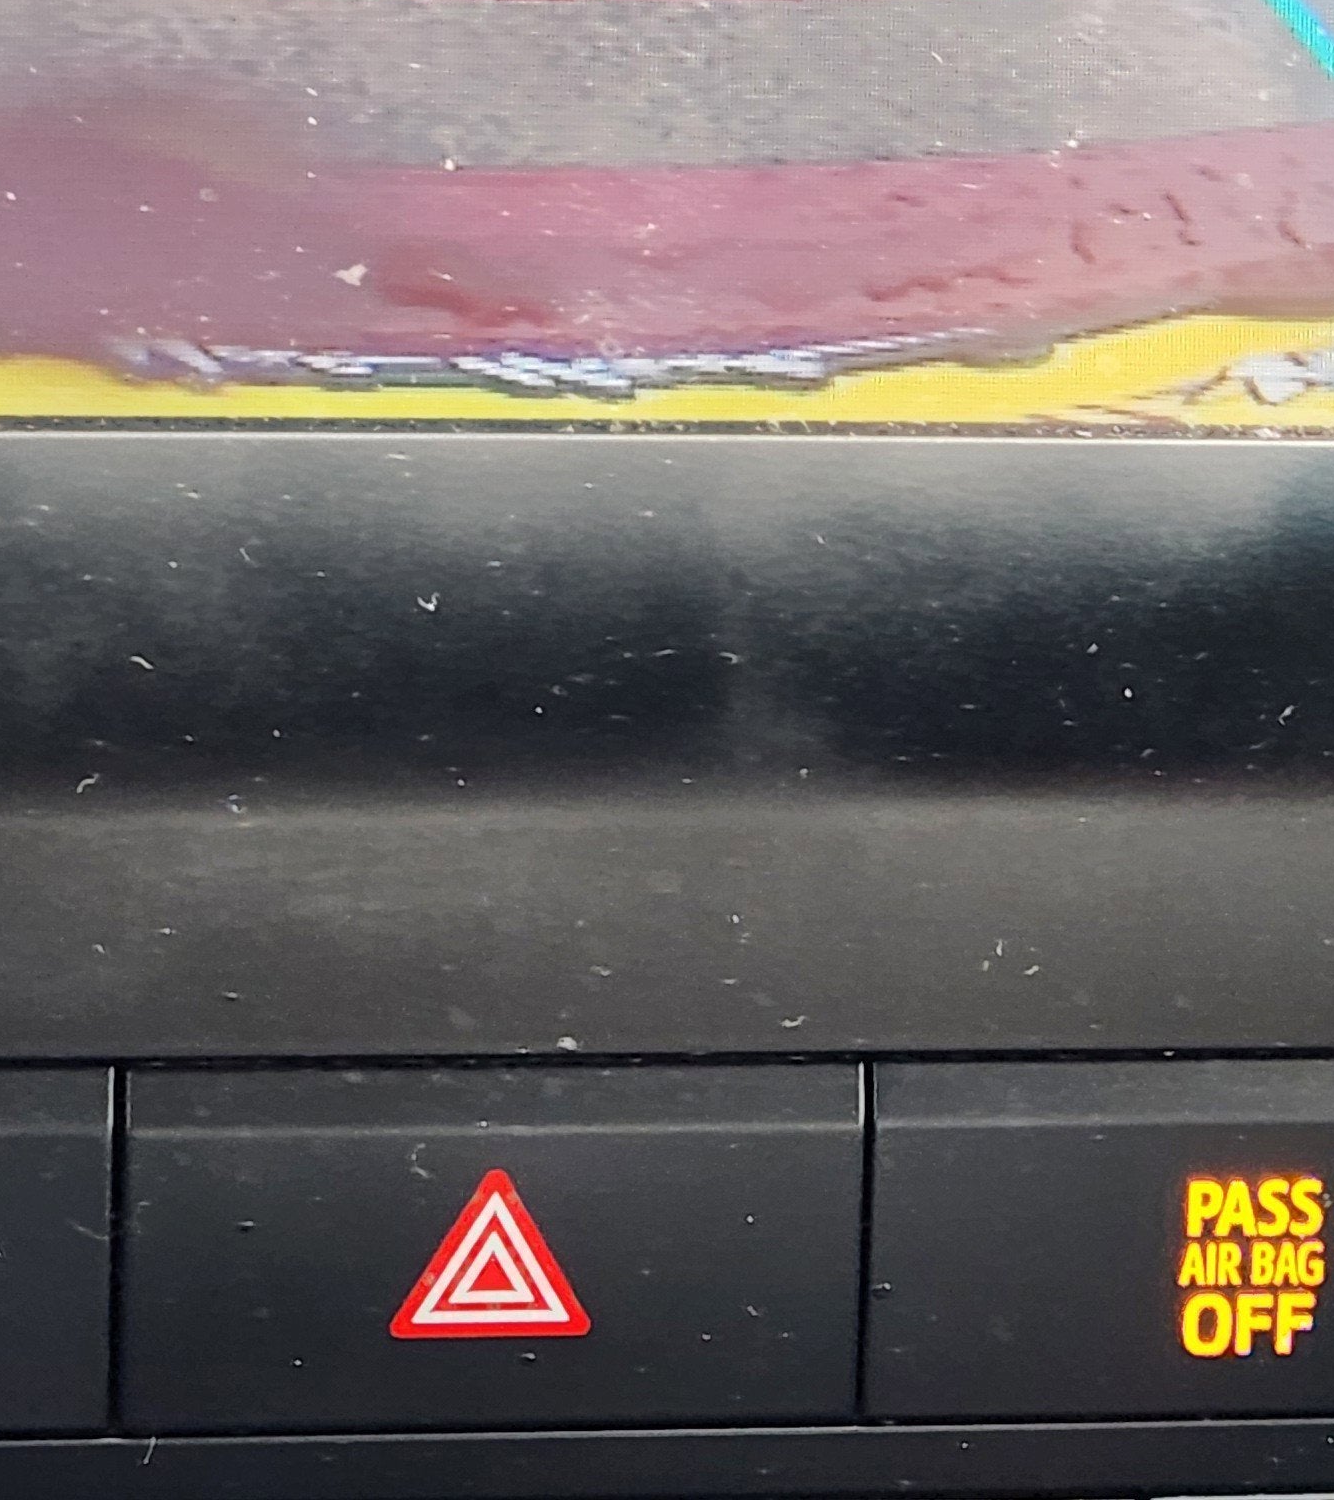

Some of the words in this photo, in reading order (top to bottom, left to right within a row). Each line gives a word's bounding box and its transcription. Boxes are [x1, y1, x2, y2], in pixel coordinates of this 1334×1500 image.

[1186, 1178, 1324, 1238] PASS
[1177, 1242, 1242, 1287] AIR
[1250, 1241, 1325, 1286] BAG
[1182, 1292, 1316, 1357] OFF
